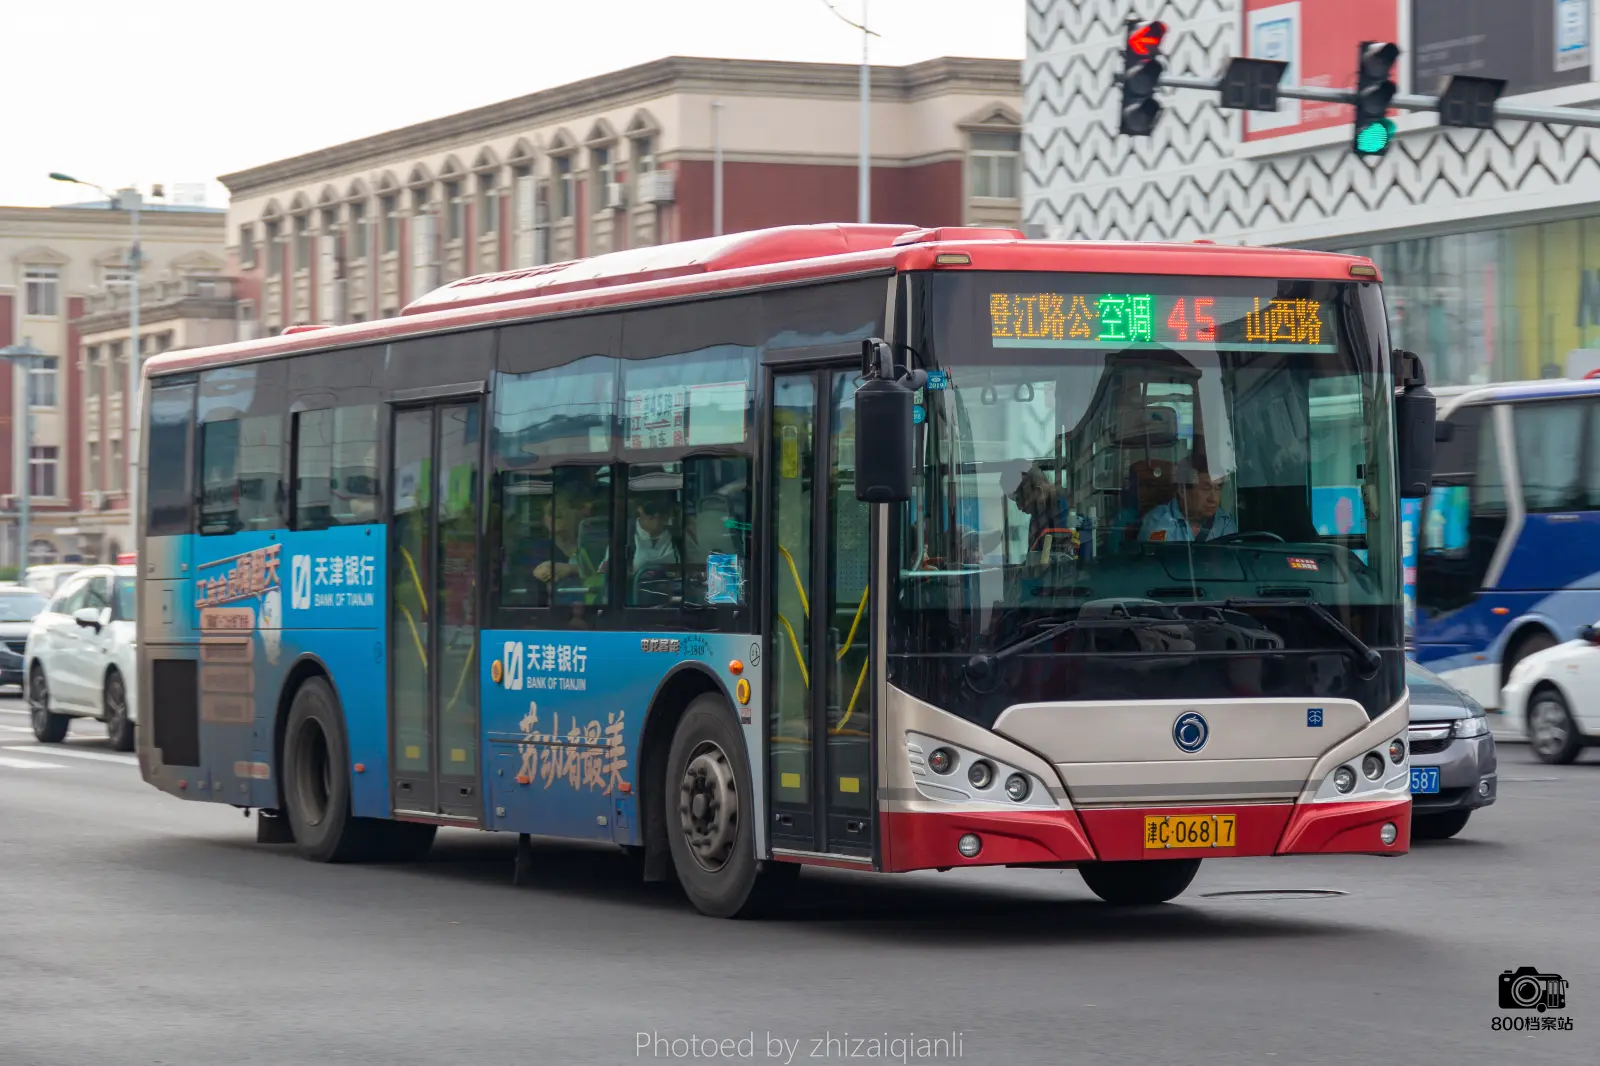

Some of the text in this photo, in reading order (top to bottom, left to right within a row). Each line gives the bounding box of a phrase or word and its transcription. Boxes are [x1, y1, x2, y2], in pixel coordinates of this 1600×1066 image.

[1099, 293, 1151, 342] 空调
[1166, 297, 1216, 342] 45
[1246, 297, 1322, 344] 山西路
[314, 555, 375, 587] 天津银行
[314, 592, 374, 607] BANK OF TIANJIN
[527, 643, 588, 673] 天津银行
[527, 676, 587, 691] BANK OF TIANJIN
